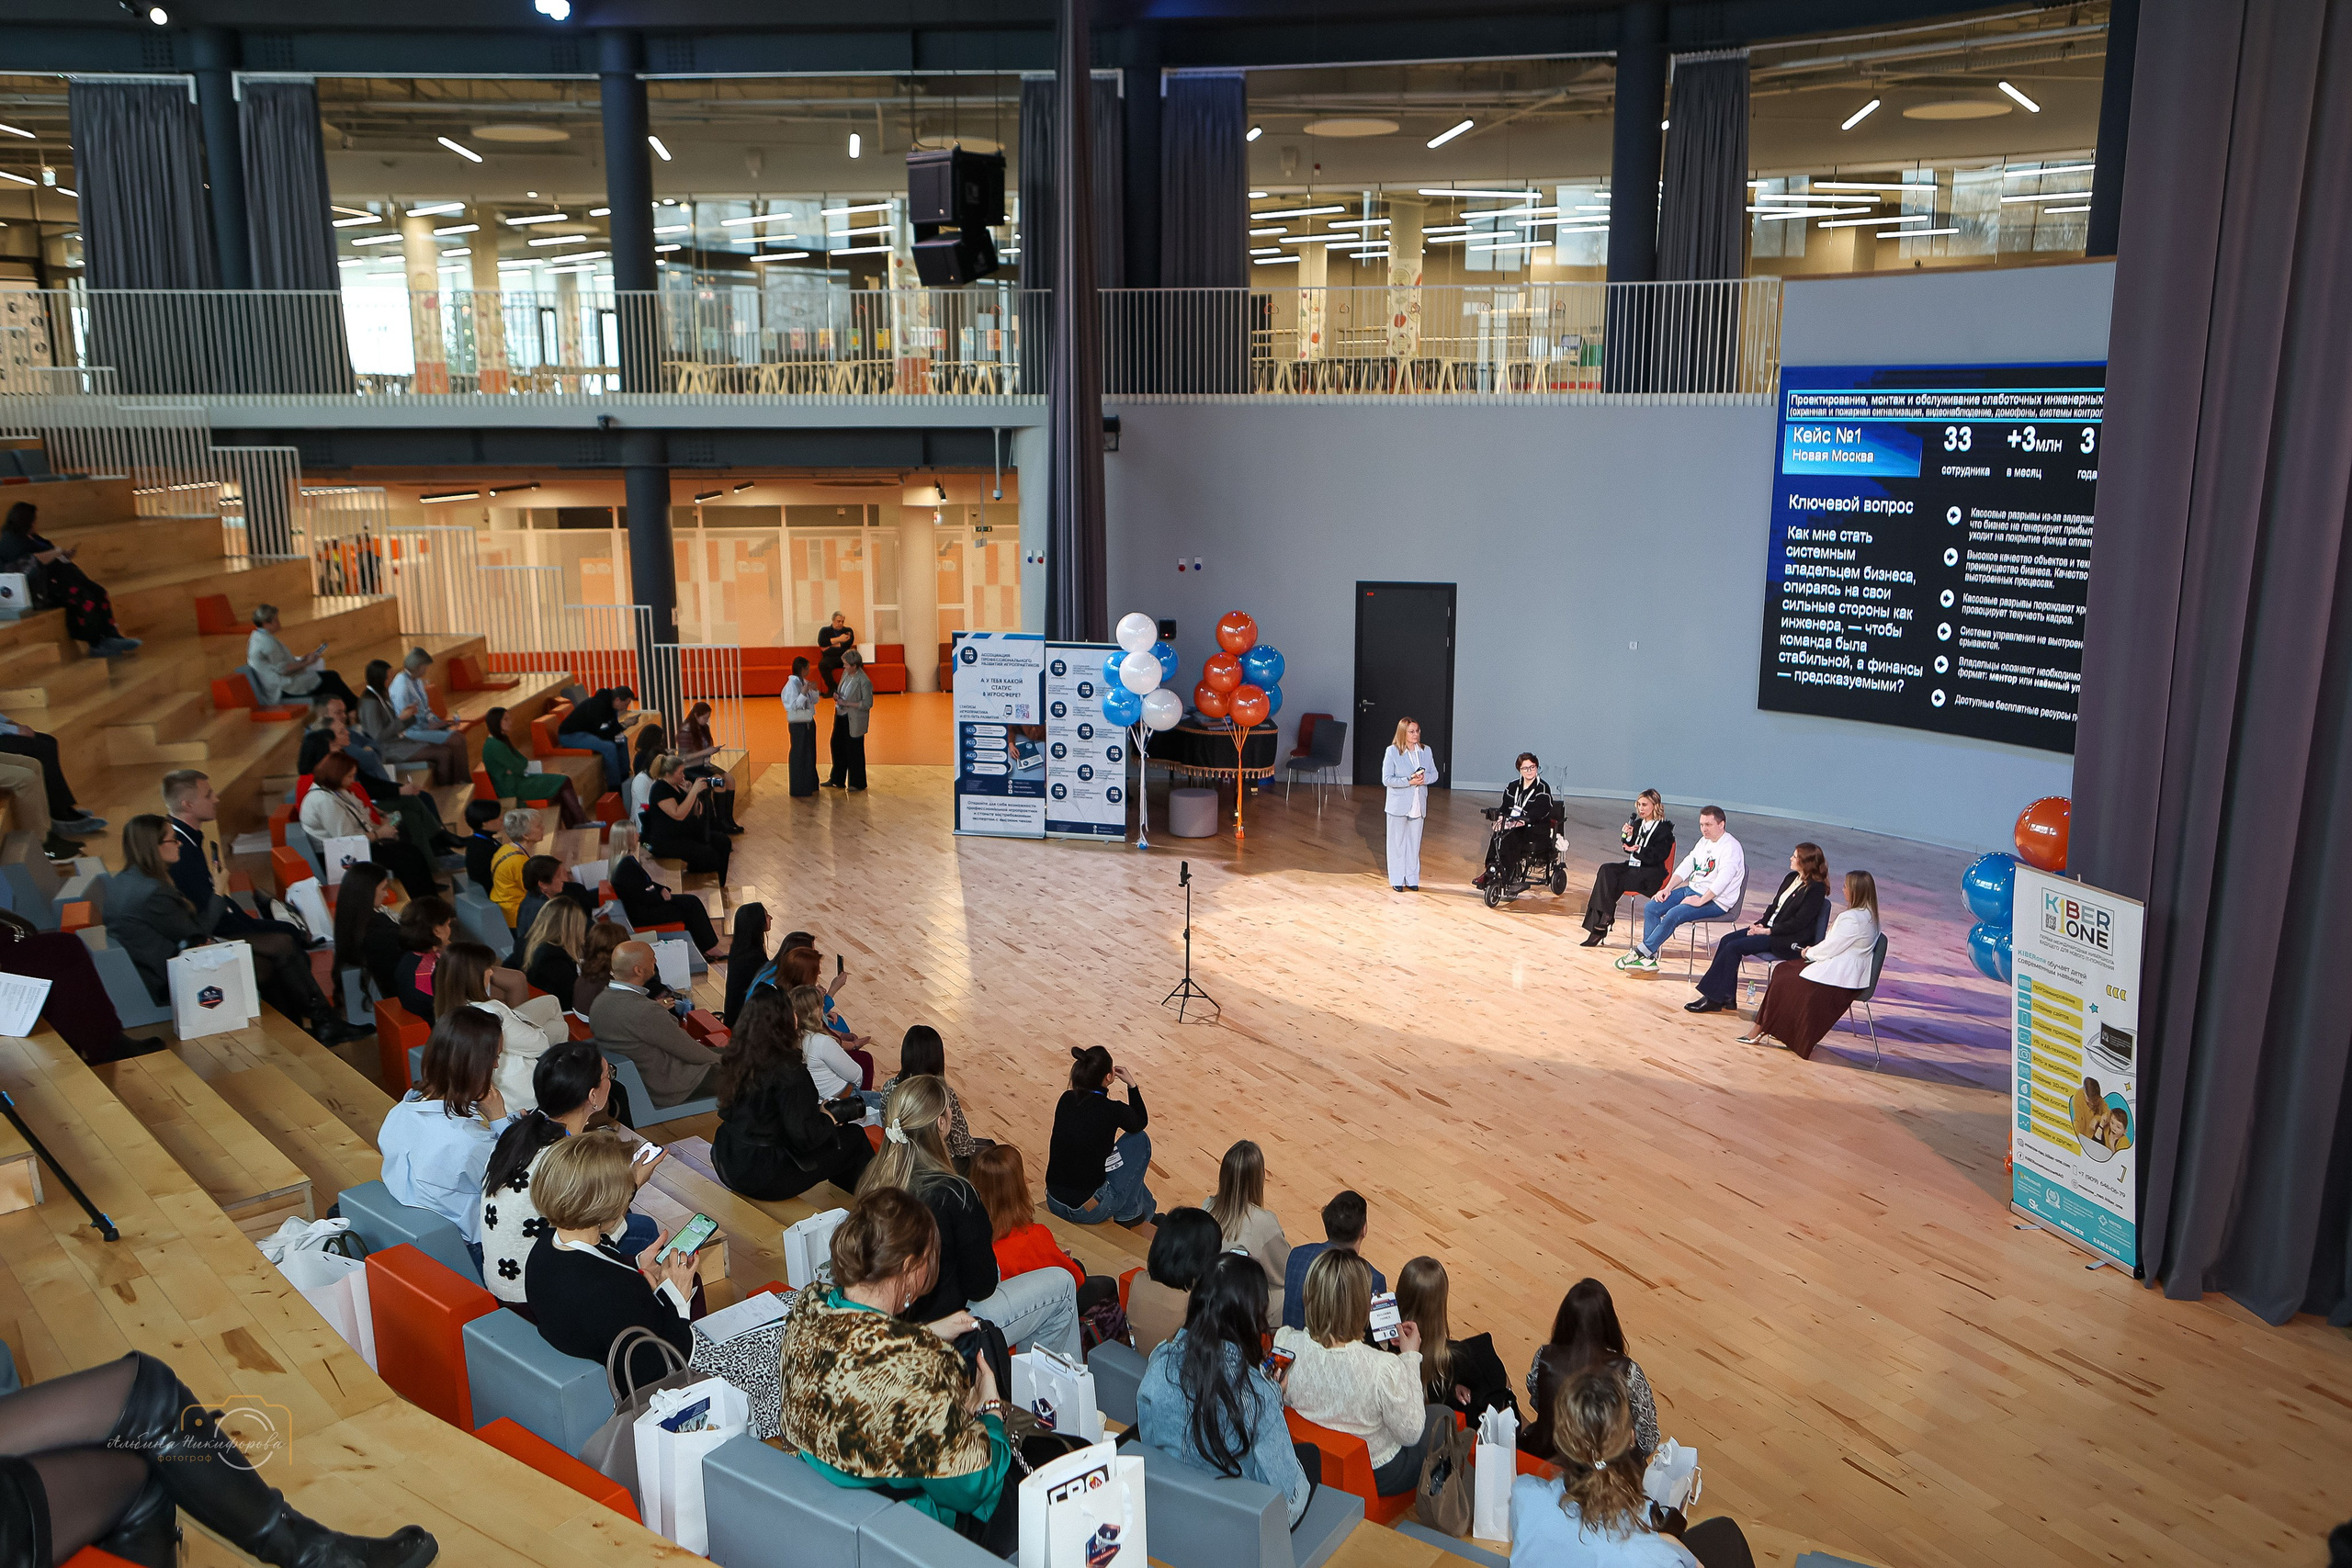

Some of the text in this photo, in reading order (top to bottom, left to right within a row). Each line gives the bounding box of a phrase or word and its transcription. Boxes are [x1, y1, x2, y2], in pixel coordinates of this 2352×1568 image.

[1791, 393, 2104, 407] Проектирование, монтаж и обслуживание слаботочных инженерных
[1790, 408, 2072, 419] (охранная и пожарная сигнализация, видеонаблюдение, домофоны, системы
[1793, 426, 1861, 445] Кейс №1
[1944, 426, 1972, 452] 33
[2080, 427, 2095, 454] 3
[1792, 449, 1874, 463] Новая Москва
[1941, 465, 1990, 478] сотрудника
[2007, 468, 2041, 480] в месяц
[2077, 468, 2098, 480] года
[1789, 494, 1914, 517] Ключевой вопрос
[1971, 507, 2007, 519] Кассовые
[2007, 511, 2041, 522] разрывы
[2042, 513, 2061, 522] из-за
[1788, 525, 1872, 544] Как мне стать
[1970, 520, 1982, 529] что
[1984, 520, 2008, 531] бизнес
[2010, 523, 2019, 531] не
[2021, 523, 2063, 535] генерирует
[1968, 531, 1993, 542] уходит
[1995, 534, 2004, 542] на
[2006, 534, 2041, 545] покрытие
[2042, 535, 2066, 547] фонда
[1786, 546, 1856, 561] системным
[1967, 549, 1998, 561] Высокое
[1999, 553, 2032, 565] качество
[2034, 555, 2068, 567] объектов
[2070, 558, 2075, 568] и
[1784, 564, 1917, 586] владельцем бизнеса,
[1965, 562, 2088, 581] преимущество бизнеса. Качество
[1783, 581, 1891, 601] опираясь на свои
[1965, 573, 2054, 590] выстроенных процессах.
[1782, 599, 1913, 621] сильные стороны как
[1962, 593, 2075, 614] Кассовые разрывы порождают
[1962, 604, 2074, 625] провоцирует текучесть кадров.
[1781, 617, 1844, 634] инженера,
[1865, 623, 1902, 637] чтобы
[1961, 626, 2046, 645] Система управления не
[1780, 634, 1867, 652] команда была
[1959, 637, 2000, 650] срываются.
[1779, 650, 1924, 678] стабильной, а финансы
[1959, 656, 1999, 671] Владельцы
[2001, 662, 2035, 675] осознают
[1794, 671, 1905, 693] предсказуемыми?
[1958, 667, 1987, 680] формат:
[1989, 671, 2018, 685] ментор
[2019, 677, 2032, 686] или
[2034, 677, 2069, 693] наёмный
[1954, 694, 2071, 722] Доступные бесплатные ресурсы
[2066, 920, 2109, 950] ONE
[2047, 960, 2070, 972] обучает
[2071, 969, 2087, 979] детей
[2033, 984, 2075, 1004] программирование
